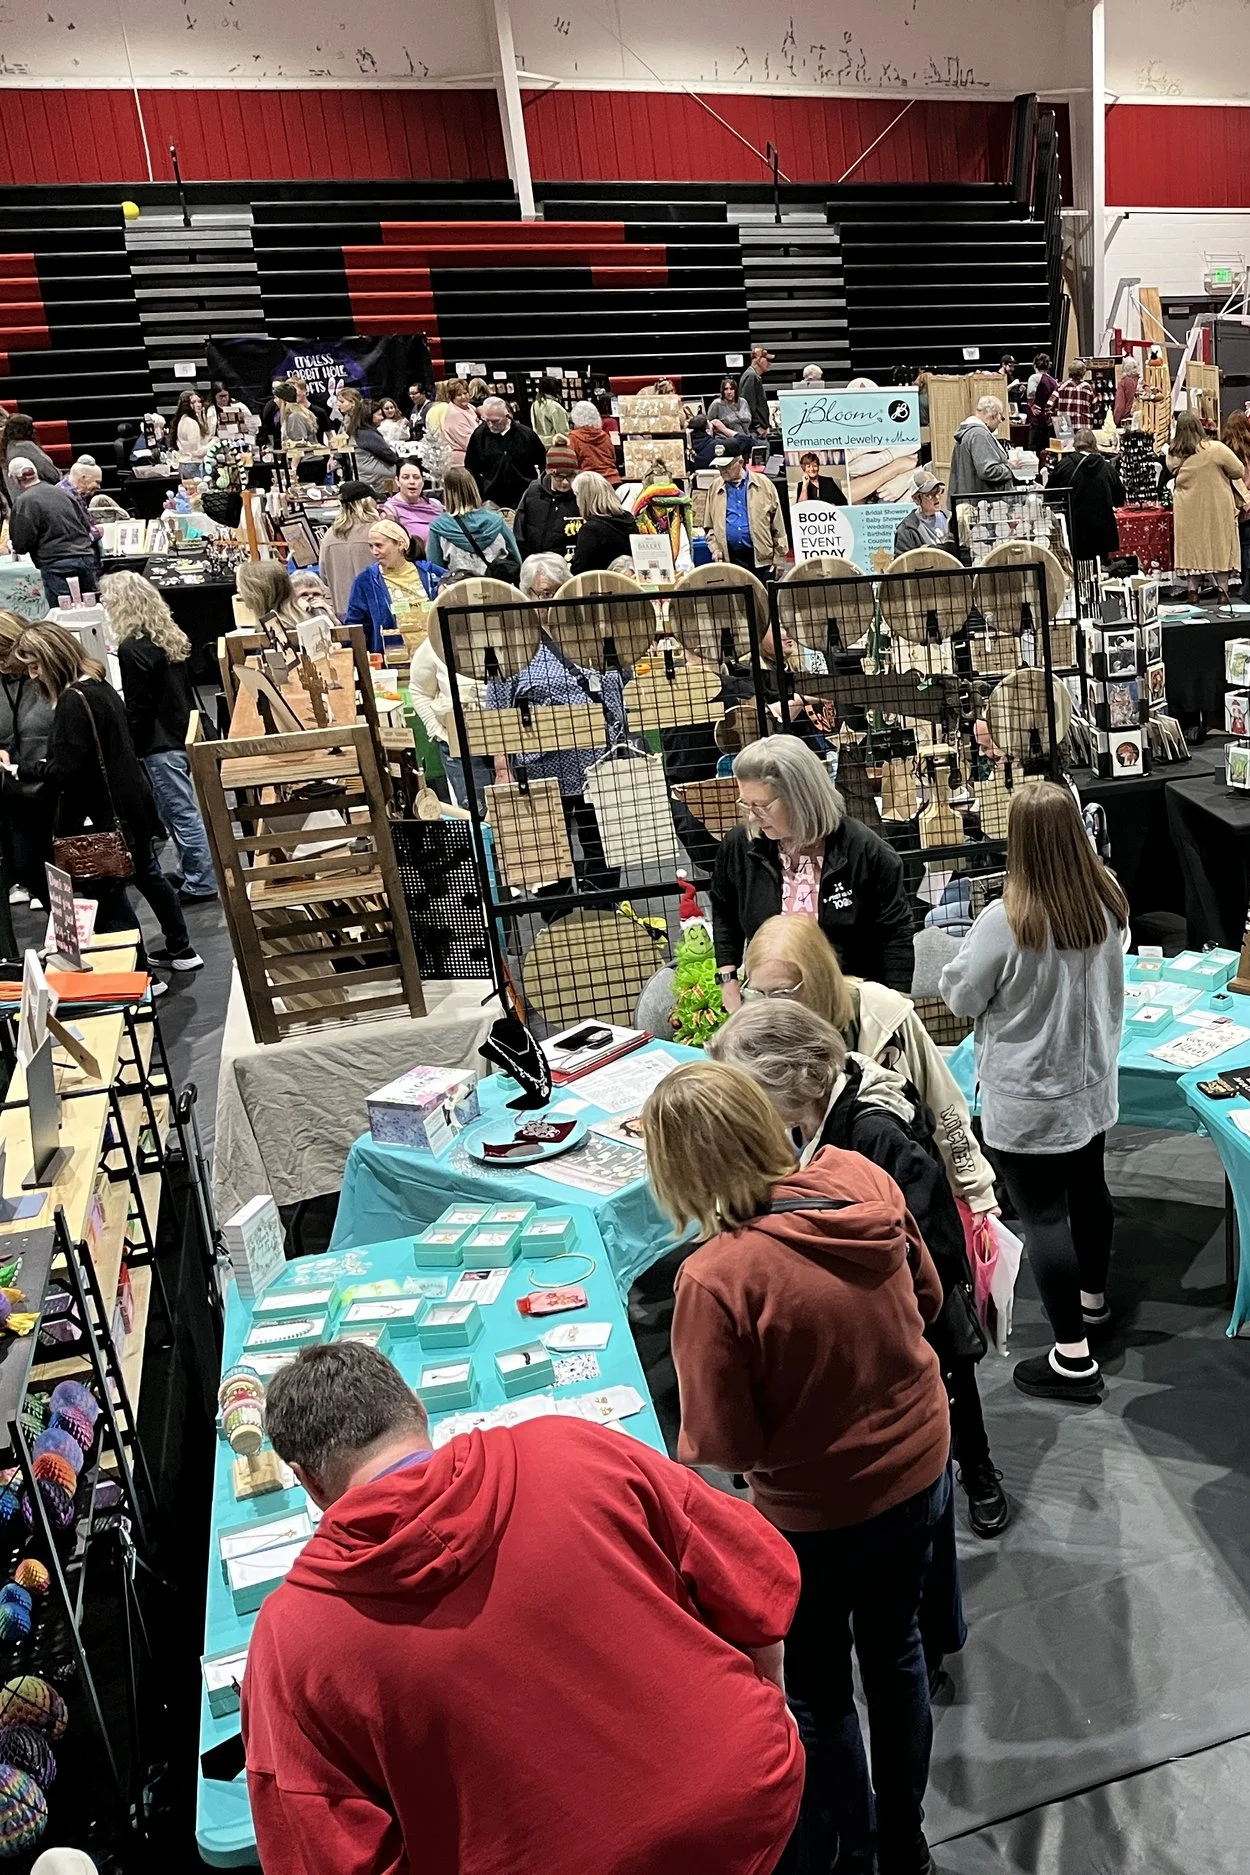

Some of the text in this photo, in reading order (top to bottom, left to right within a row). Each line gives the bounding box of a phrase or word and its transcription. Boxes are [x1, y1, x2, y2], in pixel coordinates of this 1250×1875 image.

[294, 353, 334, 369] ENDLESS
[322, 364, 348, 379] HOLE
[788, 397, 883, 435] jBloom
[787, 436, 842, 447] Permanent
[844, 435, 883, 446] Jewelry
[890, 431, 919, 443] More
[798, 511, 837, 523] BOOK
[799, 524, 835, 535] YOUR
[801, 536, 842, 548] EVENT
